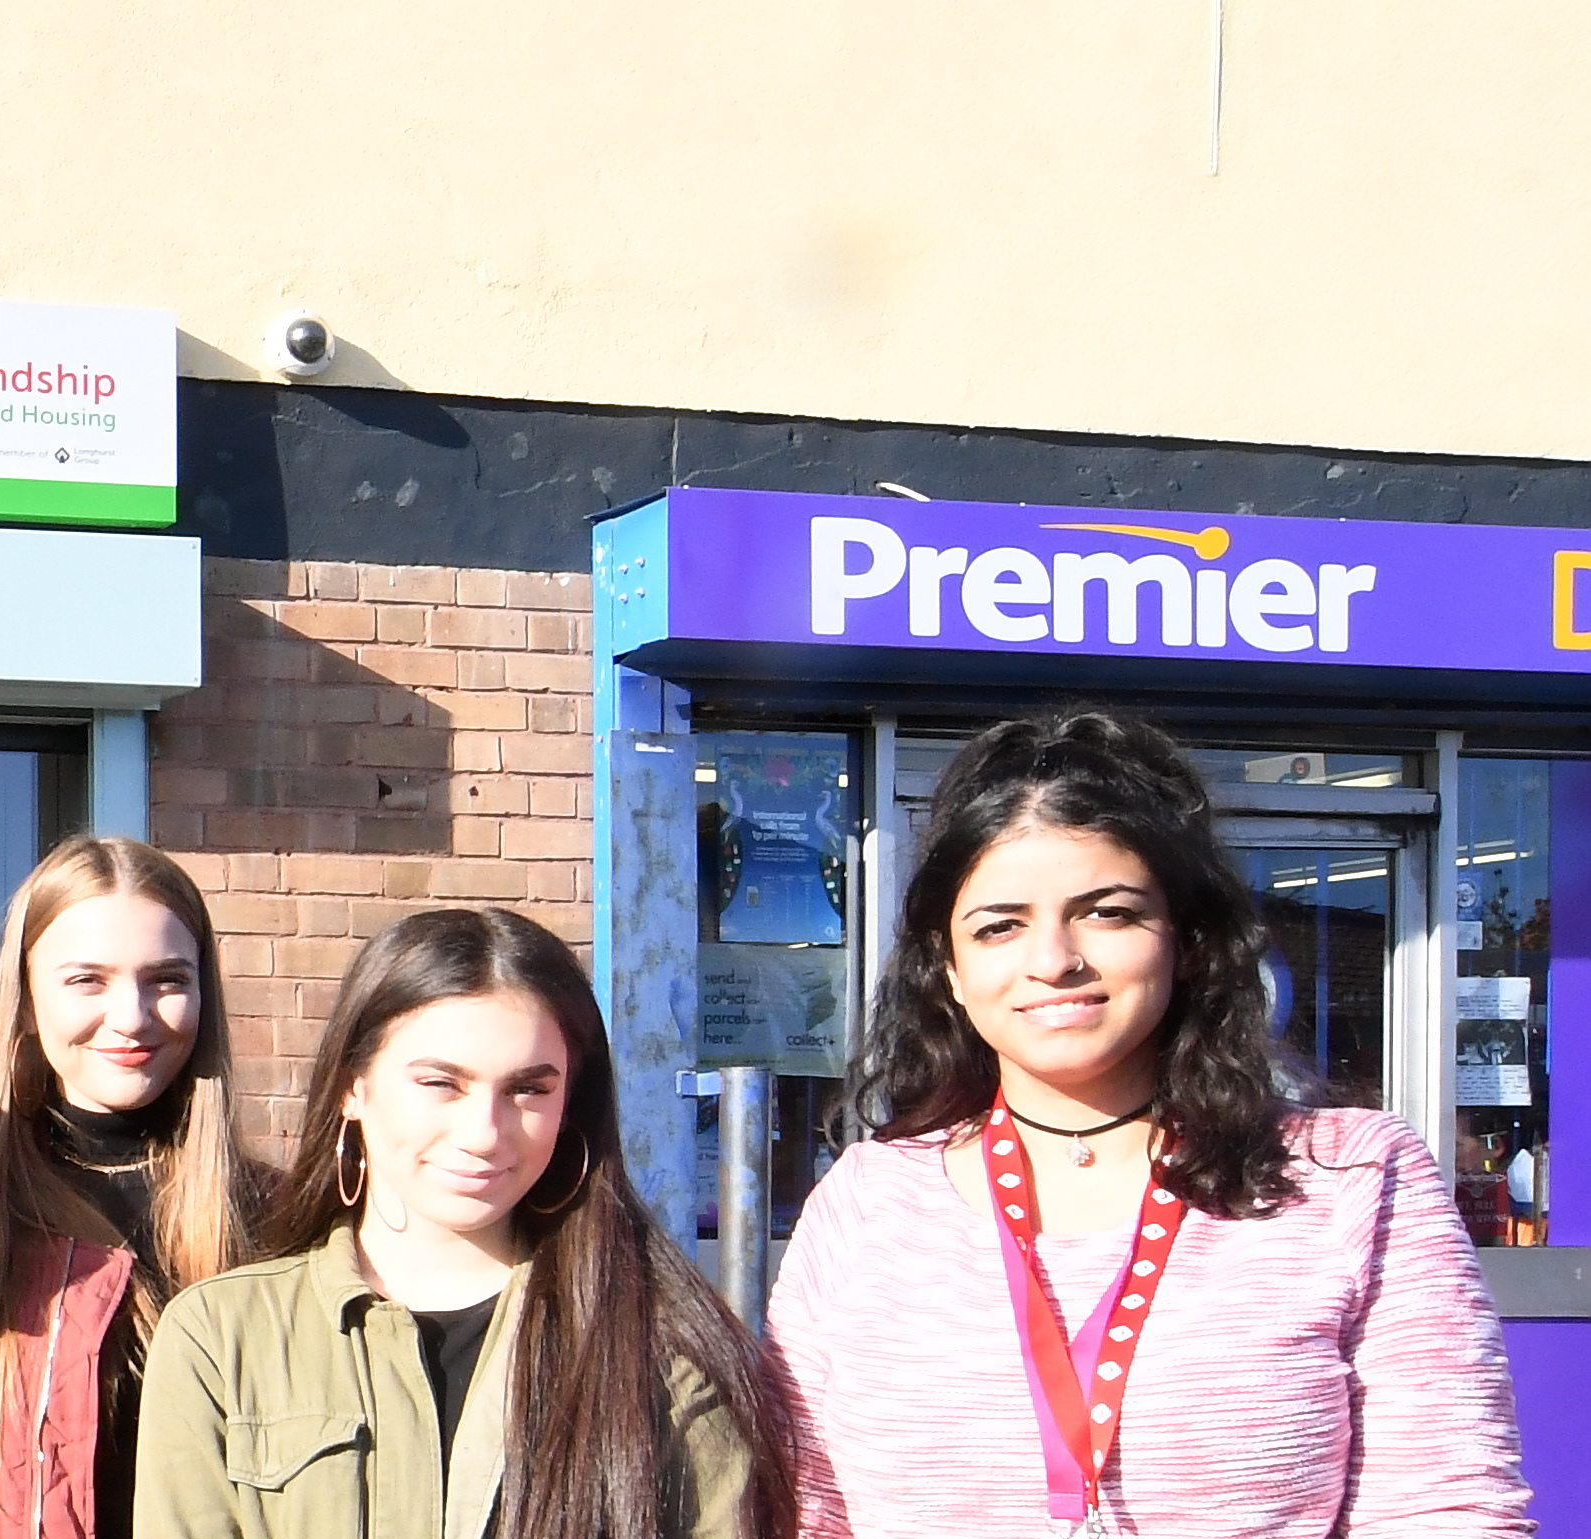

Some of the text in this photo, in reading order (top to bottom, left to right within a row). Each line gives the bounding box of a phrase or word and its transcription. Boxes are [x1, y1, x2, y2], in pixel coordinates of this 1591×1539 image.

[21, 404, 117, 433] Housing
[38, 450, 49, 459] of
[809, 516, 1377, 653] Premier
[703, 969, 736, 985] send
[703, 990, 746, 1006] collect
[704, 1009, 751, 1028] parcels
